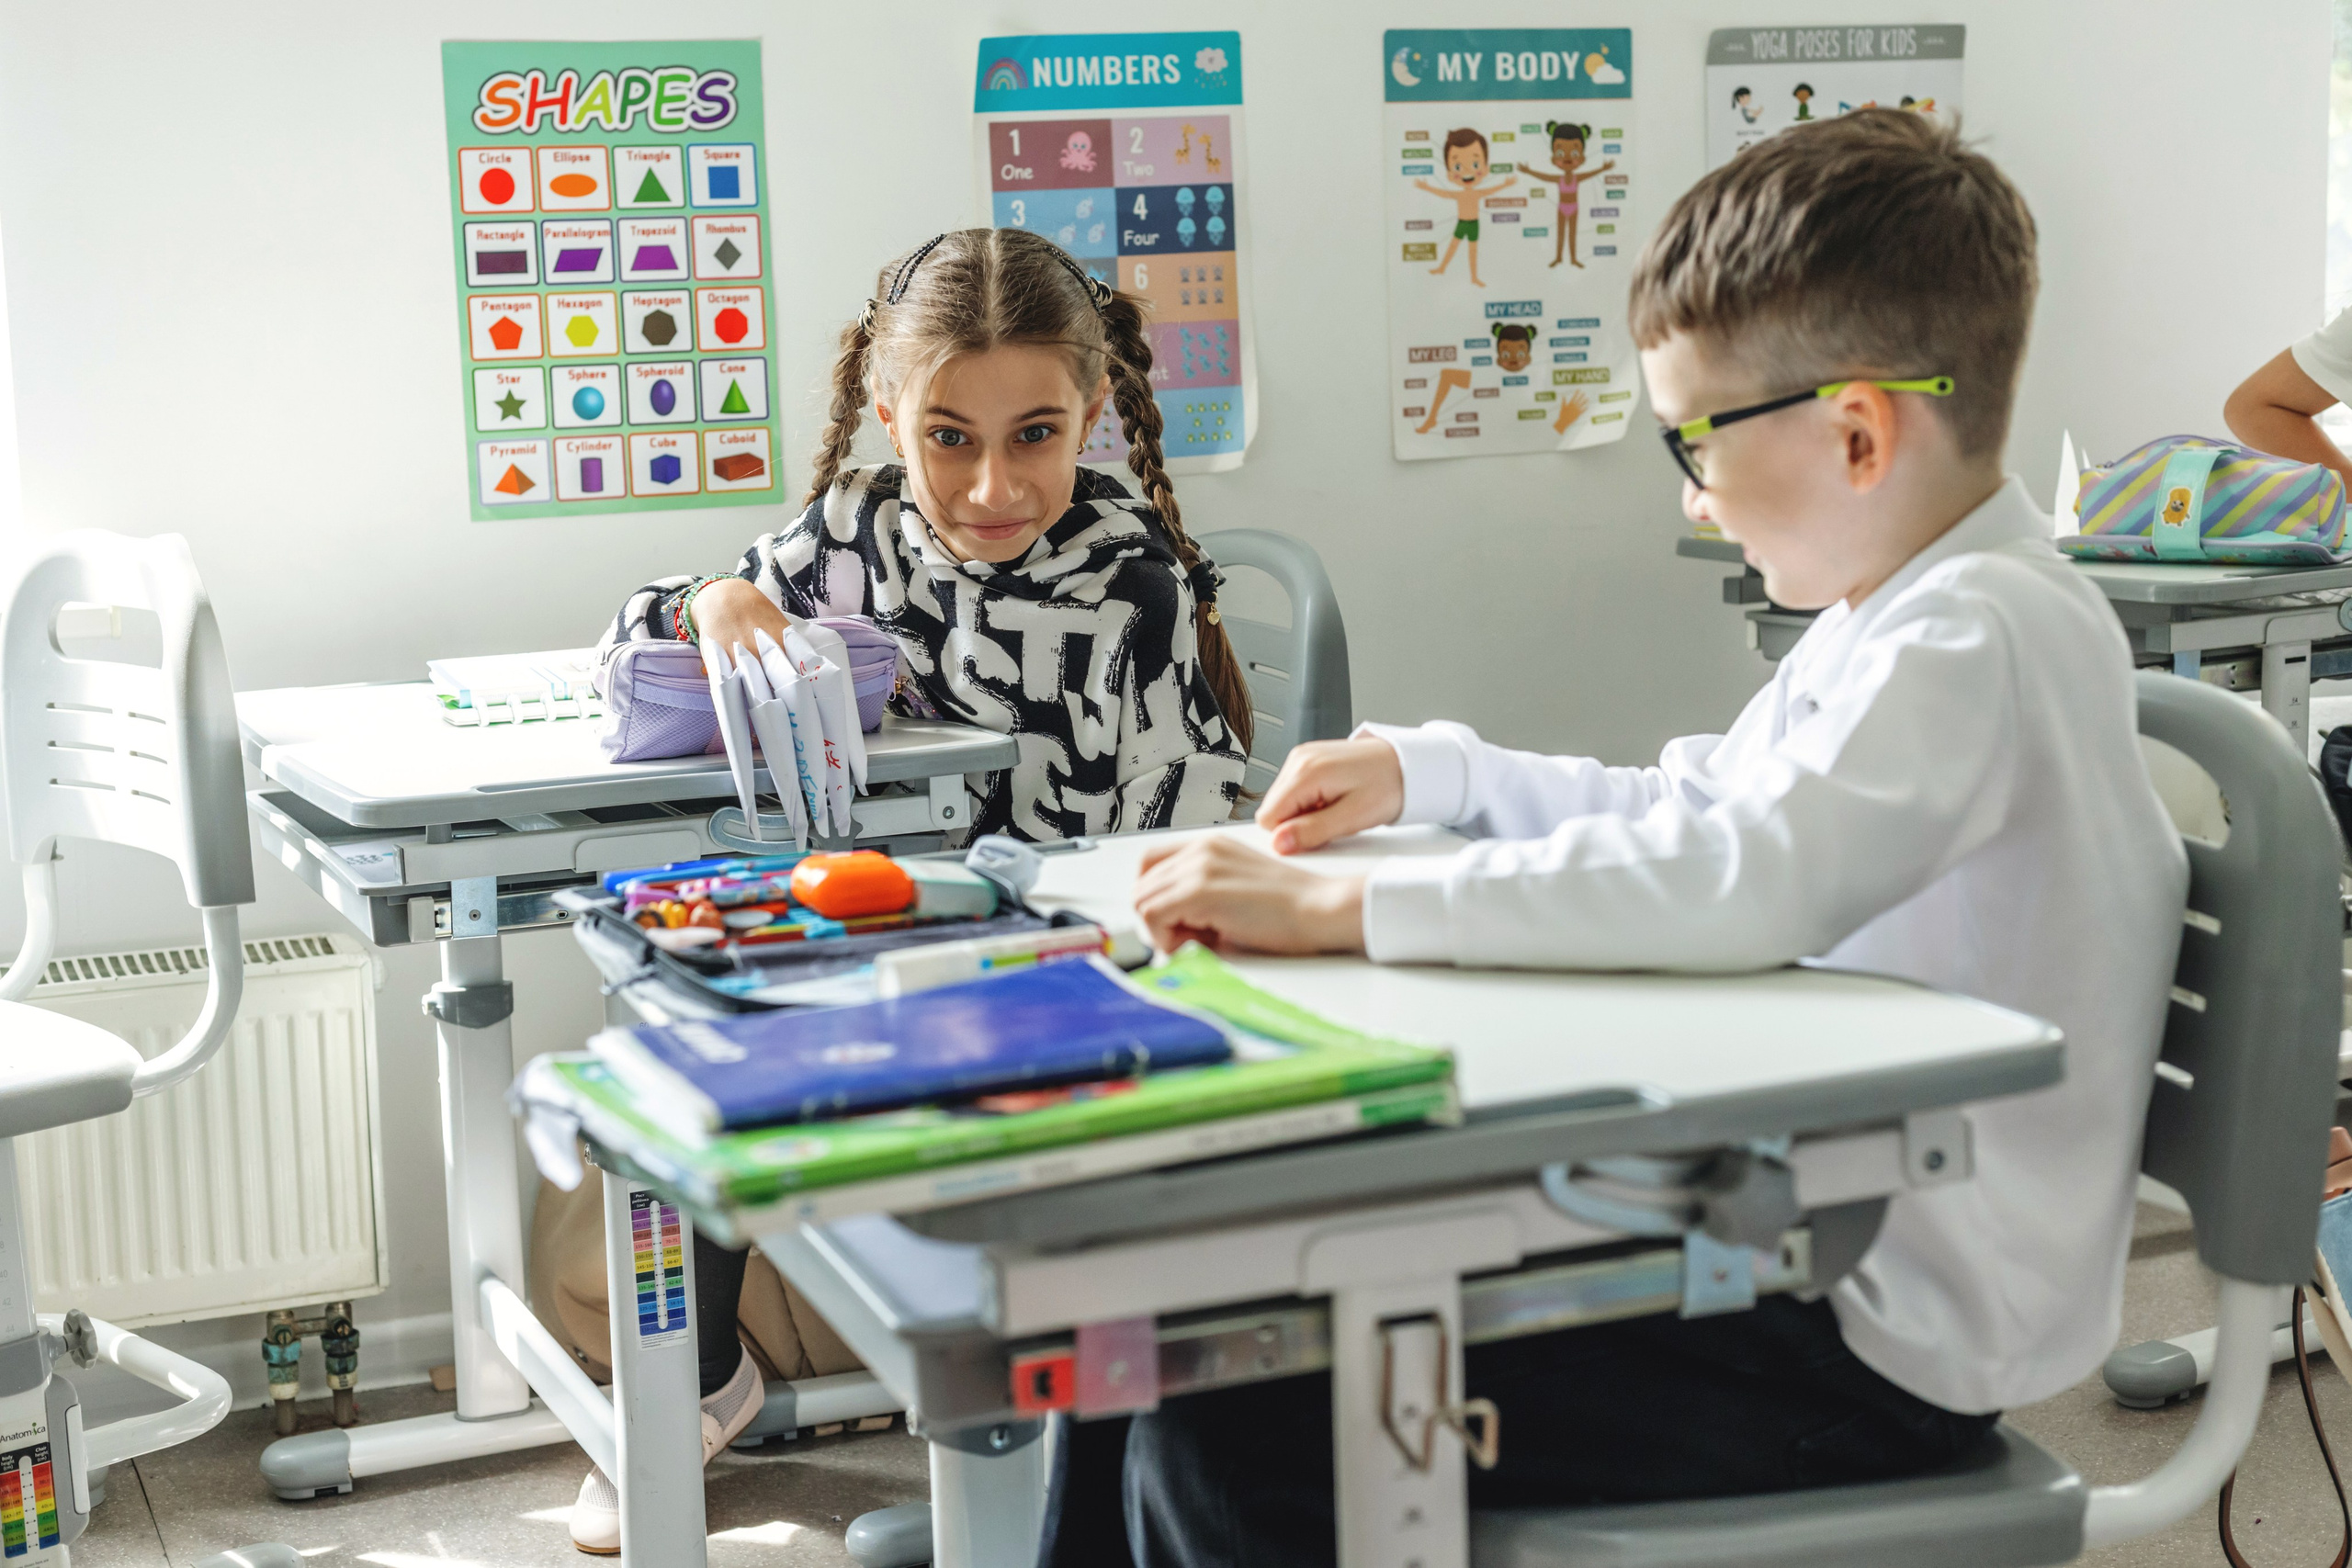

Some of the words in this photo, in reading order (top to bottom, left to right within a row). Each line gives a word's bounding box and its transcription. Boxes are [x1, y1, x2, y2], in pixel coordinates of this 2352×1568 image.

[1750, 31, 1788, 59] YOGA
[1795, 29, 1840, 58] POSES
[1847, 28, 1874, 57] FOR
[1881, 28, 1917, 56] KIDS
[1033, 54, 1182, 87] NUMBERS
[1438, 52, 1482, 81] MY
[1496, 51, 1579, 81] BODY
[473, 66, 737, 134] SHAPES
[1009, 130, 1021, 155] 1
[1130, 127, 1144, 153] 2
[479, 152, 512, 164] Circle
[553, 152, 591, 164] Ellipse
[627, 151, 671, 163] Triangle
[704, 150, 741, 162] Square
[1001, 164, 1034, 180] One
[1123, 161, 1155, 176] Two
[1012, 199, 1025, 226] 3
[1133, 194, 1148, 220] 4
[545, 227, 611, 240] Parallelogram
[630, 225, 677, 237] Trapezoid
[706, 224, 746, 234] Rhombus
[476, 230, 525, 242] Rectangle
[1123, 230, 1159, 245] Four
[1135, 263, 1148, 289] 6
[557, 299, 603, 310] Hexagon
[633, 295, 683, 308] Heptagon
[707, 293, 750, 305] Octagon
[481, 300, 532, 312] Pentagon
[1487, 304, 1507, 316] MY
[1509, 301, 1541, 315] HEAD
[1411, 349, 1430, 361] MY
[1433, 347, 1455, 360] LEG
[568, 369, 607, 381] Sphere
[636, 366, 684, 378] Spheroid
[718, 363, 746, 374] Cone
[496, 373, 522, 385] Star
[1555, 371, 1574, 384] MY
[1576, 369, 1609, 383] HAND
[649, 438, 677, 448] Cube
[718, 434, 756, 445] Cuboid
[490, 445, 537, 457] Pyramid
[566, 442, 613, 455] Cylinder
